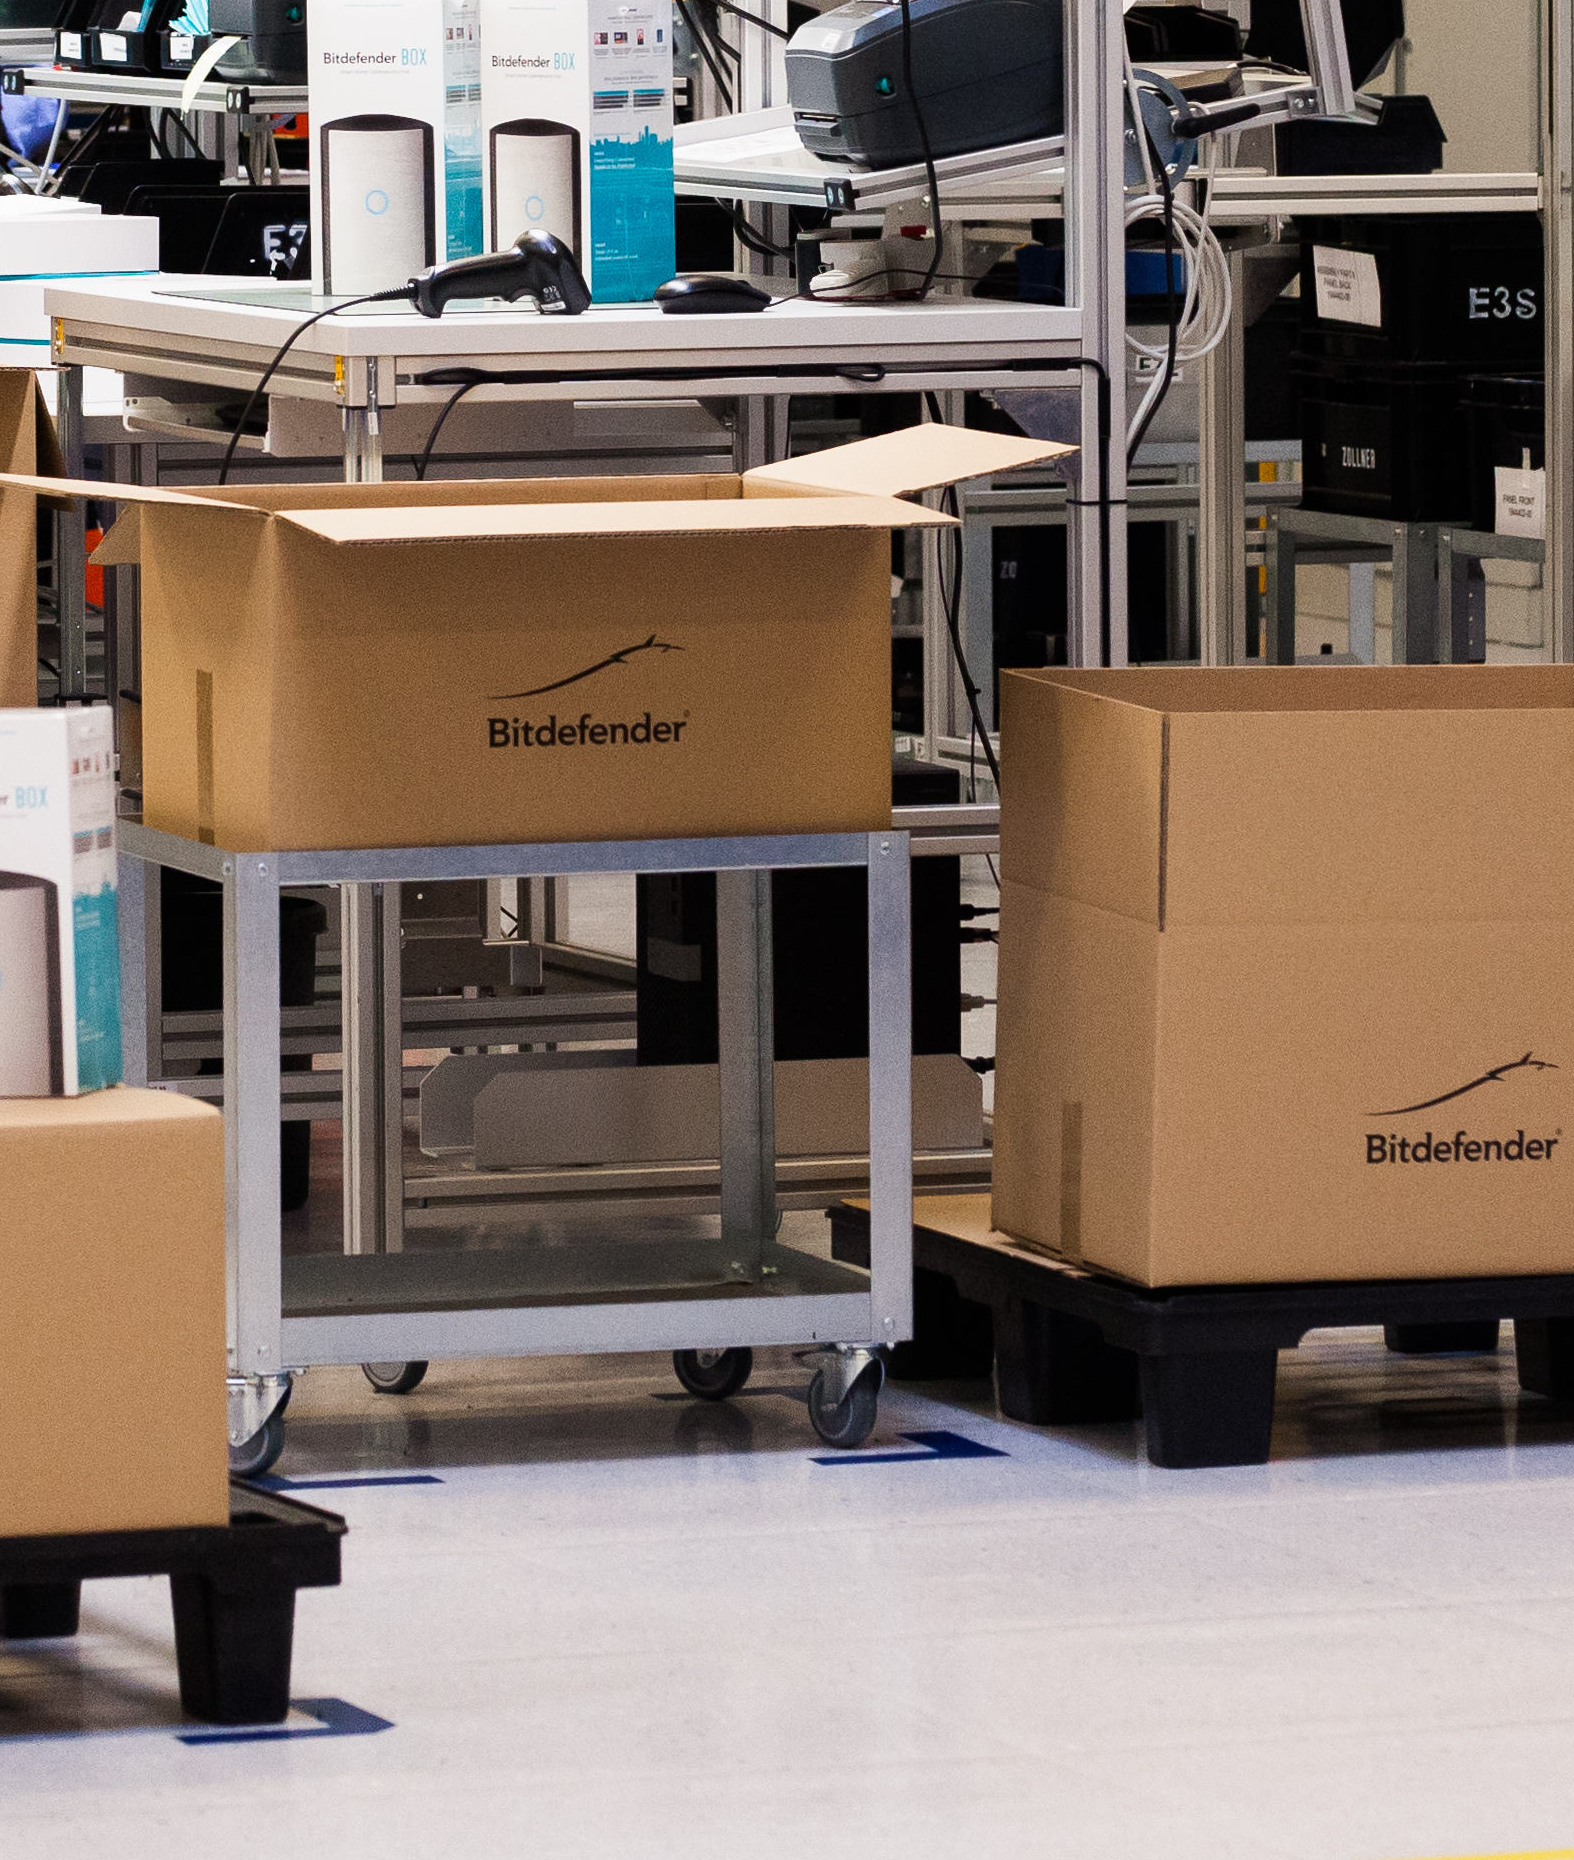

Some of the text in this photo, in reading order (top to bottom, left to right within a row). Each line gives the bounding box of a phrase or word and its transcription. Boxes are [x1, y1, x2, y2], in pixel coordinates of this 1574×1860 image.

[323, 48, 427, 65] Bitdefender BOX
[491, 52, 575, 70] Bitdefender BOX
[1469, 286, 1537, 319] E3S
[488, 712, 686, 748] Bitdefender
[15, 786, 47, 808] BOX
[1366, 1130, 1558, 1164] Bitdefender
